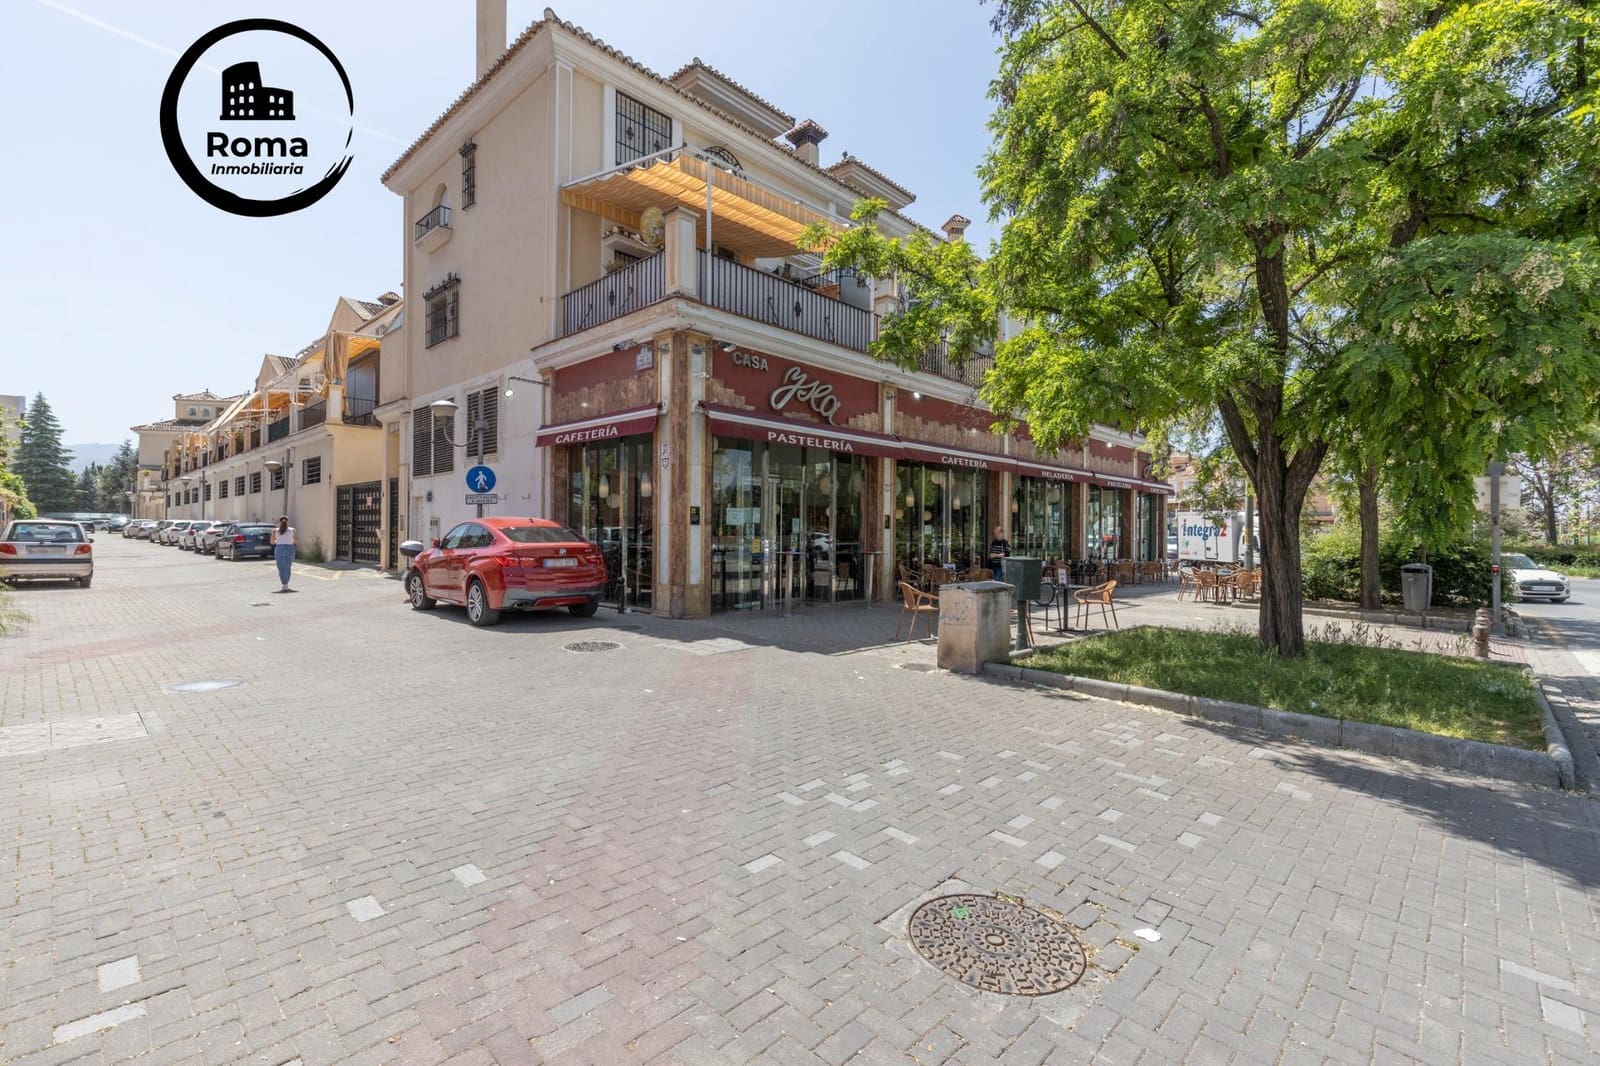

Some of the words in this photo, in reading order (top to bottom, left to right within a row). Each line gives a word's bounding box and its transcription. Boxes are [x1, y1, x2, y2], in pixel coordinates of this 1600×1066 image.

[732, 351, 769, 372] CASA
[555, 424, 619, 444] CAFETERÍA
[767, 431, 853, 452] PASTELERÍA
